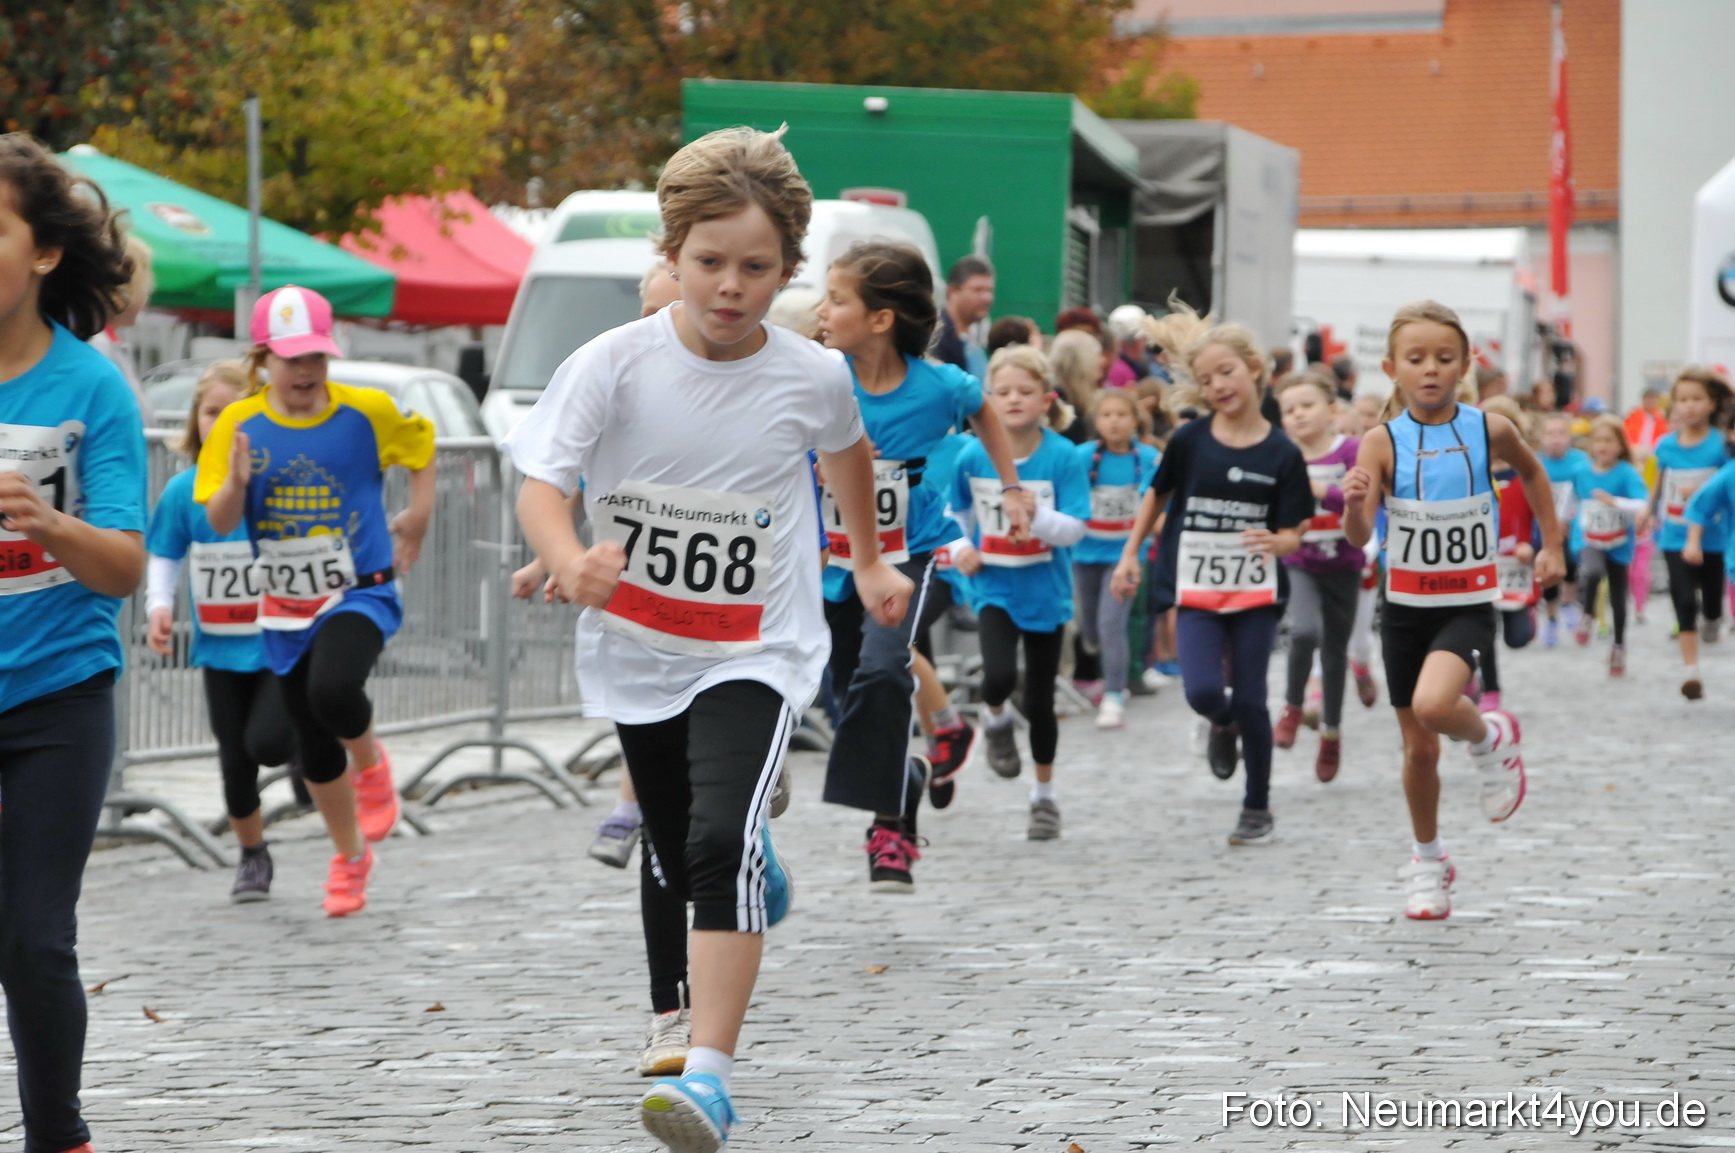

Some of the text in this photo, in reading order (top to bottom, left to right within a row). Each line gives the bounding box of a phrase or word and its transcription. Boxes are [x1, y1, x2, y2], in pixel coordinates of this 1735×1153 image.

[660, 503, 748, 526] Neumarkt
[1426, 509, 1479, 521] Neumarkt
[612, 515, 757, 595] 7568
[1398, 522, 1487, 565] 7080
[261, 558, 345, 594] 7215
[1190, 553, 1267, 585] 7573
[1419, 576, 1468, 591] Felina
